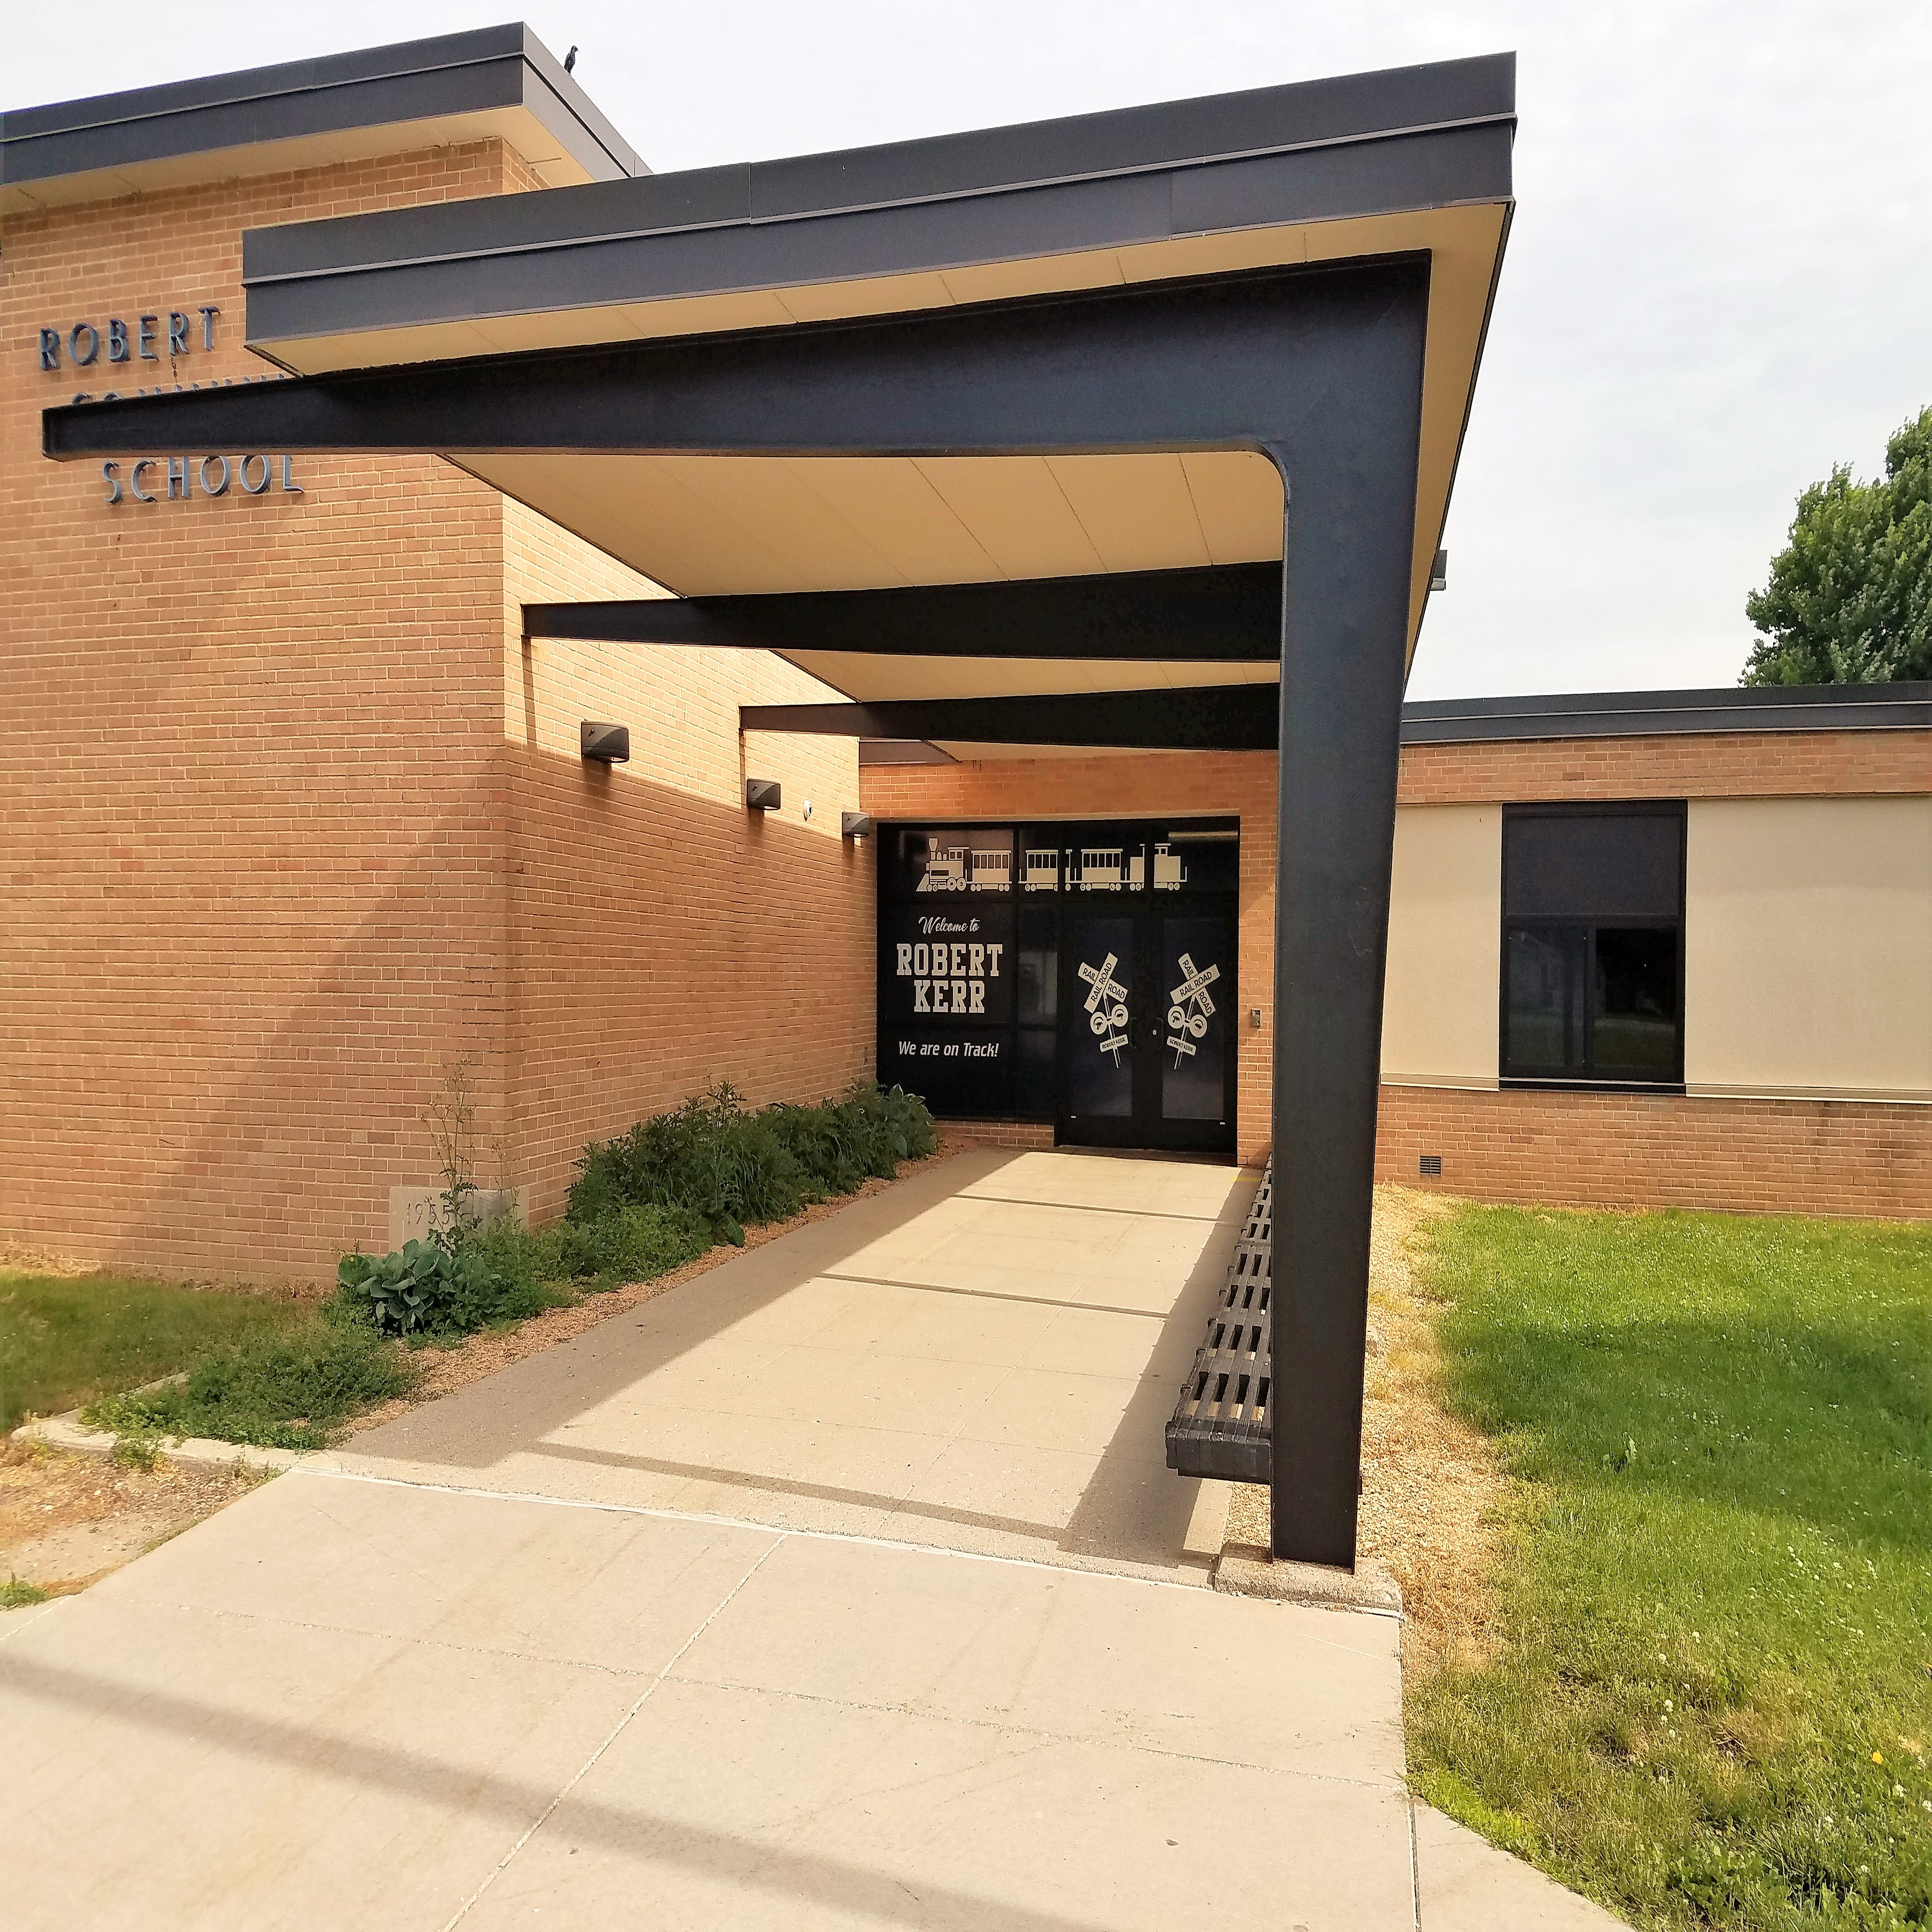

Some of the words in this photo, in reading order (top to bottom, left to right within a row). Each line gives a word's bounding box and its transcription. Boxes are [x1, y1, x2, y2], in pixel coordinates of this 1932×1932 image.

[40, 306, 220, 371] ROBERT
[102, 455, 305, 504] SCHOOL
[918, 917, 967, 934] Welcome
[968, 917, 980, 932] to
[896, 943, 1003, 977] ROBERT
[1183, 960, 1196, 978] RAIL
[1082, 968, 1096, 981] RAIL
[1091, 984, 1102, 1002] RAIL
[1099, 962, 1112, 984] ROAD
[1179, 982, 1194, 997] RAIL
[1193, 971, 1212, 987] ROAD
[914, 980, 985, 1014] KERR
[1108, 983, 1125, 999] ROAD
[1198, 991, 1212, 1014] ROAD
[899, 1041, 916, 1055] We
[920, 1044, 939, 1056] are
[943, 1044, 959, 1056] on
[964, 1042, 999, 1057] Track!
[407, 1203, 450, 1225] 1955
